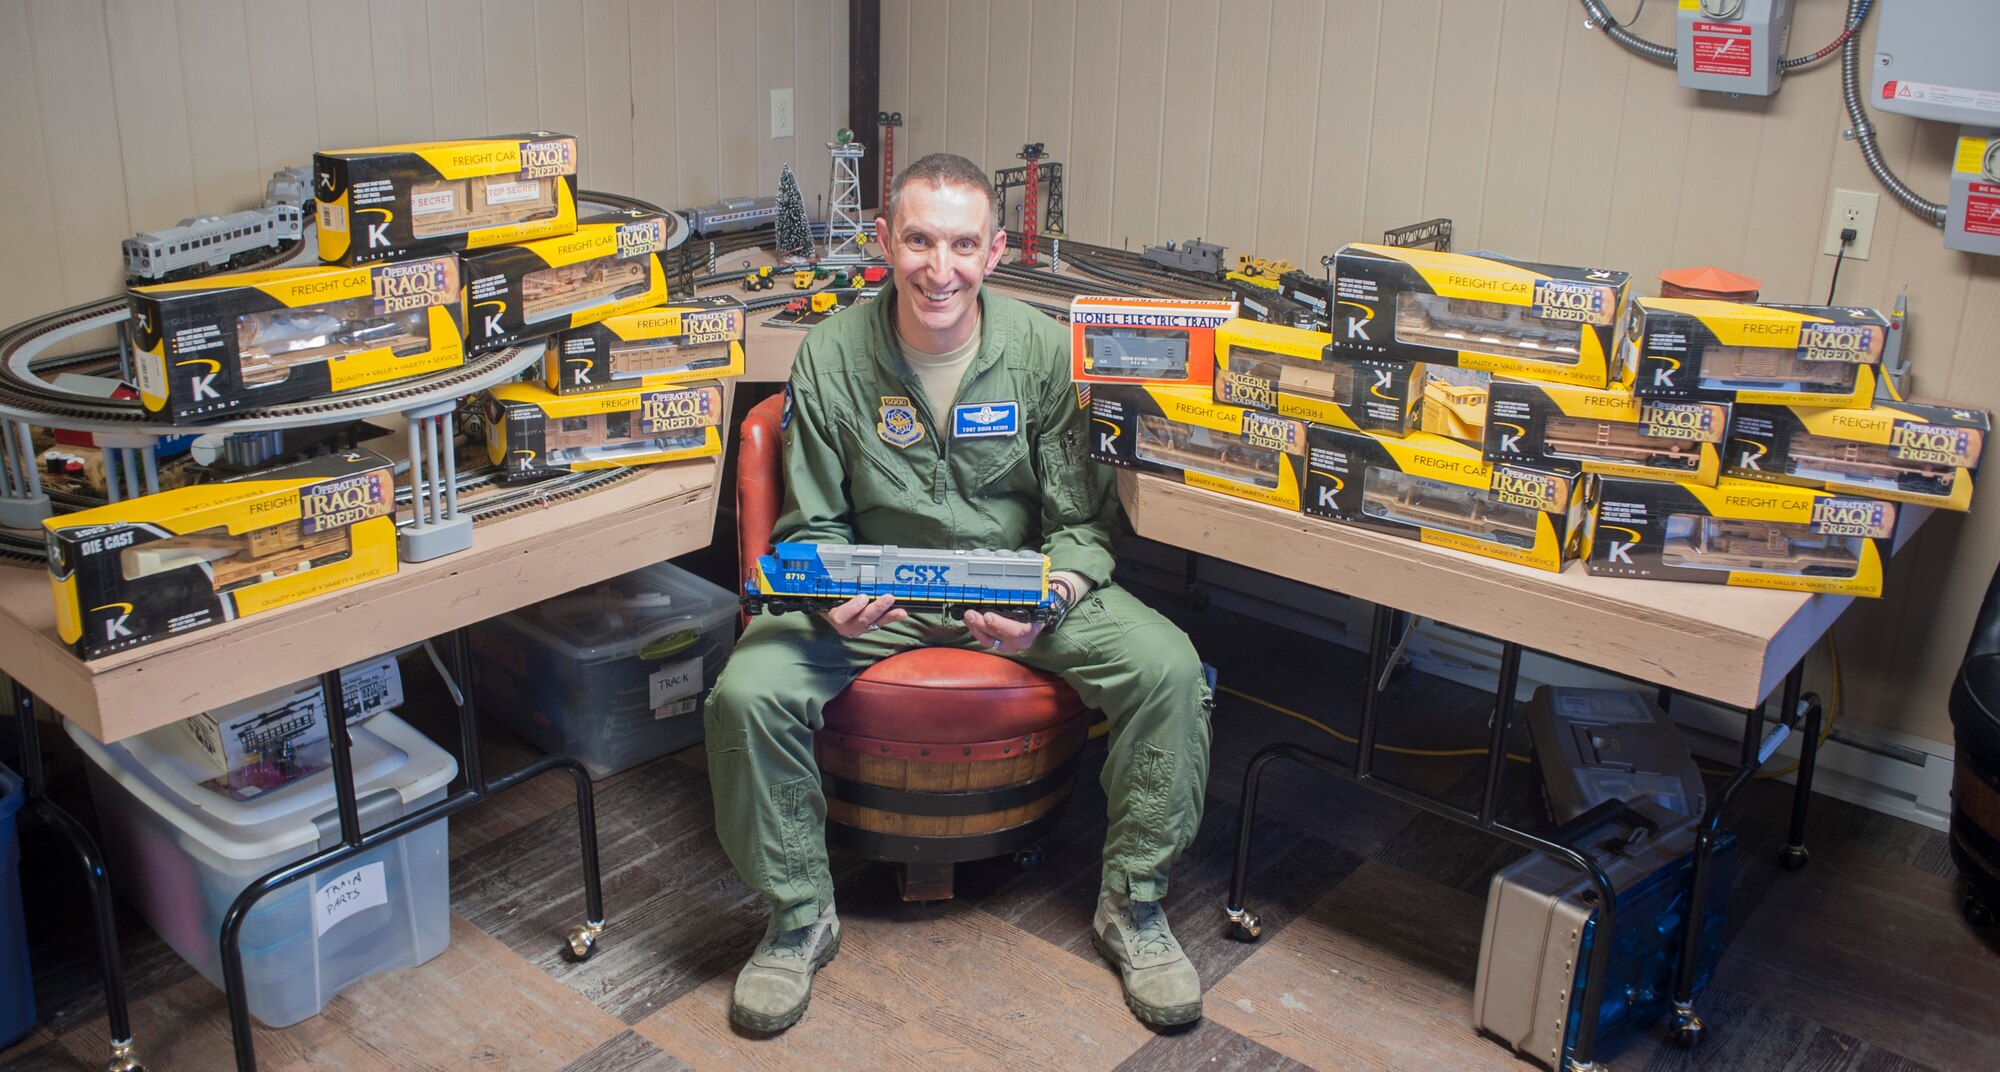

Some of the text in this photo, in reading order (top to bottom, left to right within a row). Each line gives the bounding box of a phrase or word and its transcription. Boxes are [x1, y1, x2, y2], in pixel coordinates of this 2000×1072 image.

[527, 142, 562, 151] OPERATION
[453, 151, 516, 166] FREIGHT CAR
[521, 149, 564, 168] IRAQI
[489, 183, 537, 196] TOP SECRET
[418, 195, 451, 206] SECRET
[368, 223, 391, 248] K
[470, 222, 574, 243] QUALITY VALUE VARIETY SERVICE
[622, 221, 654, 233] OPERATION
[558, 235, 613, 255] FREIGHT CAR
[617, 227, 655, 248] IRAQI
[382, 263, 435, 278] OPERATION
[292, 275, 367, 296] FREIGHT CAR
[373, 271, 437, 300] IRAQI
[1449, 276, 1527, 294] FREIGHT CAR
[1545, 281, 1594, 295] OPERATION
[1535, 287, 1595, 310] IRAQI
[574, 294, 665, 323] QUALITY VALUE VARIETY SERVICE
[689, 312, 727, 321] OPERATION
[484, 313, 505, 338] K
[637, 317, 677, 328] FREIGHT
[682, 318, 729, 335] IRAQI
[1074, 313, 1118, 324] LIONEL
[1124, 315, 1180, 326] ELECTRIC
[1348, 317, 1370, 340] K
[1811, 322, 1863, 334] OPERATION
[1743, 324, 1796, 336] FREIGHT
[1801, 329, 1862, 350] IRAQI
[335, 353, 459, 384] QUALITY VALUE VARIETY SERVICE
[575, 367, 591, 384] K
[1461, 357, 1601, 382] QUALITY VALUE VARIETY SERVICE
[1654, 369, 1675, 387] K
[192, 373, 220, 401] K
[1374, 370, 1392, 388] K
[601, 397, 638, 408] FREIGHT
[652, 391, 700, 402] OPERATION
[1232, 381, 1278, 408] IRAQI
[1232, 397, 1270, 410] OPERATION
[1584, 396, 1637, 409] FREIGHT
[644, 397, 703, 420] IRAQI
[1176, 402, 1237, 423] FREIGHT CAR
[1282, 404, 1323, 419] FREIGHT
[1652, 400, 1703, 413] OPERATION
[1250, 413, 1289, 427] OPERATION
[1642, 405, 1704, 429] IRAQI
[1832, 415, 1888, 431] FREIGHT
[1243, 416, 1289, 440] IRAQI
[1904, 421, 1958, 436] OPERATION
[1100, 433, 1118, 455] K
[1501, 434, 1520, 453] K
[1892, 427, 1960, 453] IRAQI
[521, 457, 535, 470] K
[1414, 454, 1488, 477] FREIGHT CAR
[1740, 451, 1761, 470] K
[1501, 467, 1548, 484] OPERATION
[1584, 463, 1609, 471] QUALITY
[1674, 472, 1698, 480] SERVICE
[311, 476, 369, 496] OPERATION
[1187, 475, 1296, 506] QUALITY VALUE VARIETY SERVICE
[1492, 472, 1547, 499] IRAQI
[250, 495, 299, 515] FREIGHT
[302, 489, 373, 521] IRAQI
[1319, 486, 1339, 510] K
[1726, 496, 1809, 510] FREIGHT CAR
[1823, 498, 1874, 510] OPERATION
[1813, 504, 1873, 525] IRAQI
[81, 531, 134, 556] DIE CAST
[1423, 533, 1555, 567] QUALITY VALUE VARIETY SERVICE
[1609, 541, 1635, 564] K
[785, 572, 806, 581] 8710
[895, 564, 949, 584] CSX
[261, 569, 381, 607] QUALITY VALUE VARIETY SERVICE
[1731, 576, 1877, 593] QUALITY VALUE VARIETY SERVICE
[105, 614, 131, 641] K
[657, 672, 688, 689] TRACK
[325, 872, 361, 898] TRAIN
[326, 888, 360, 915] PARTS
